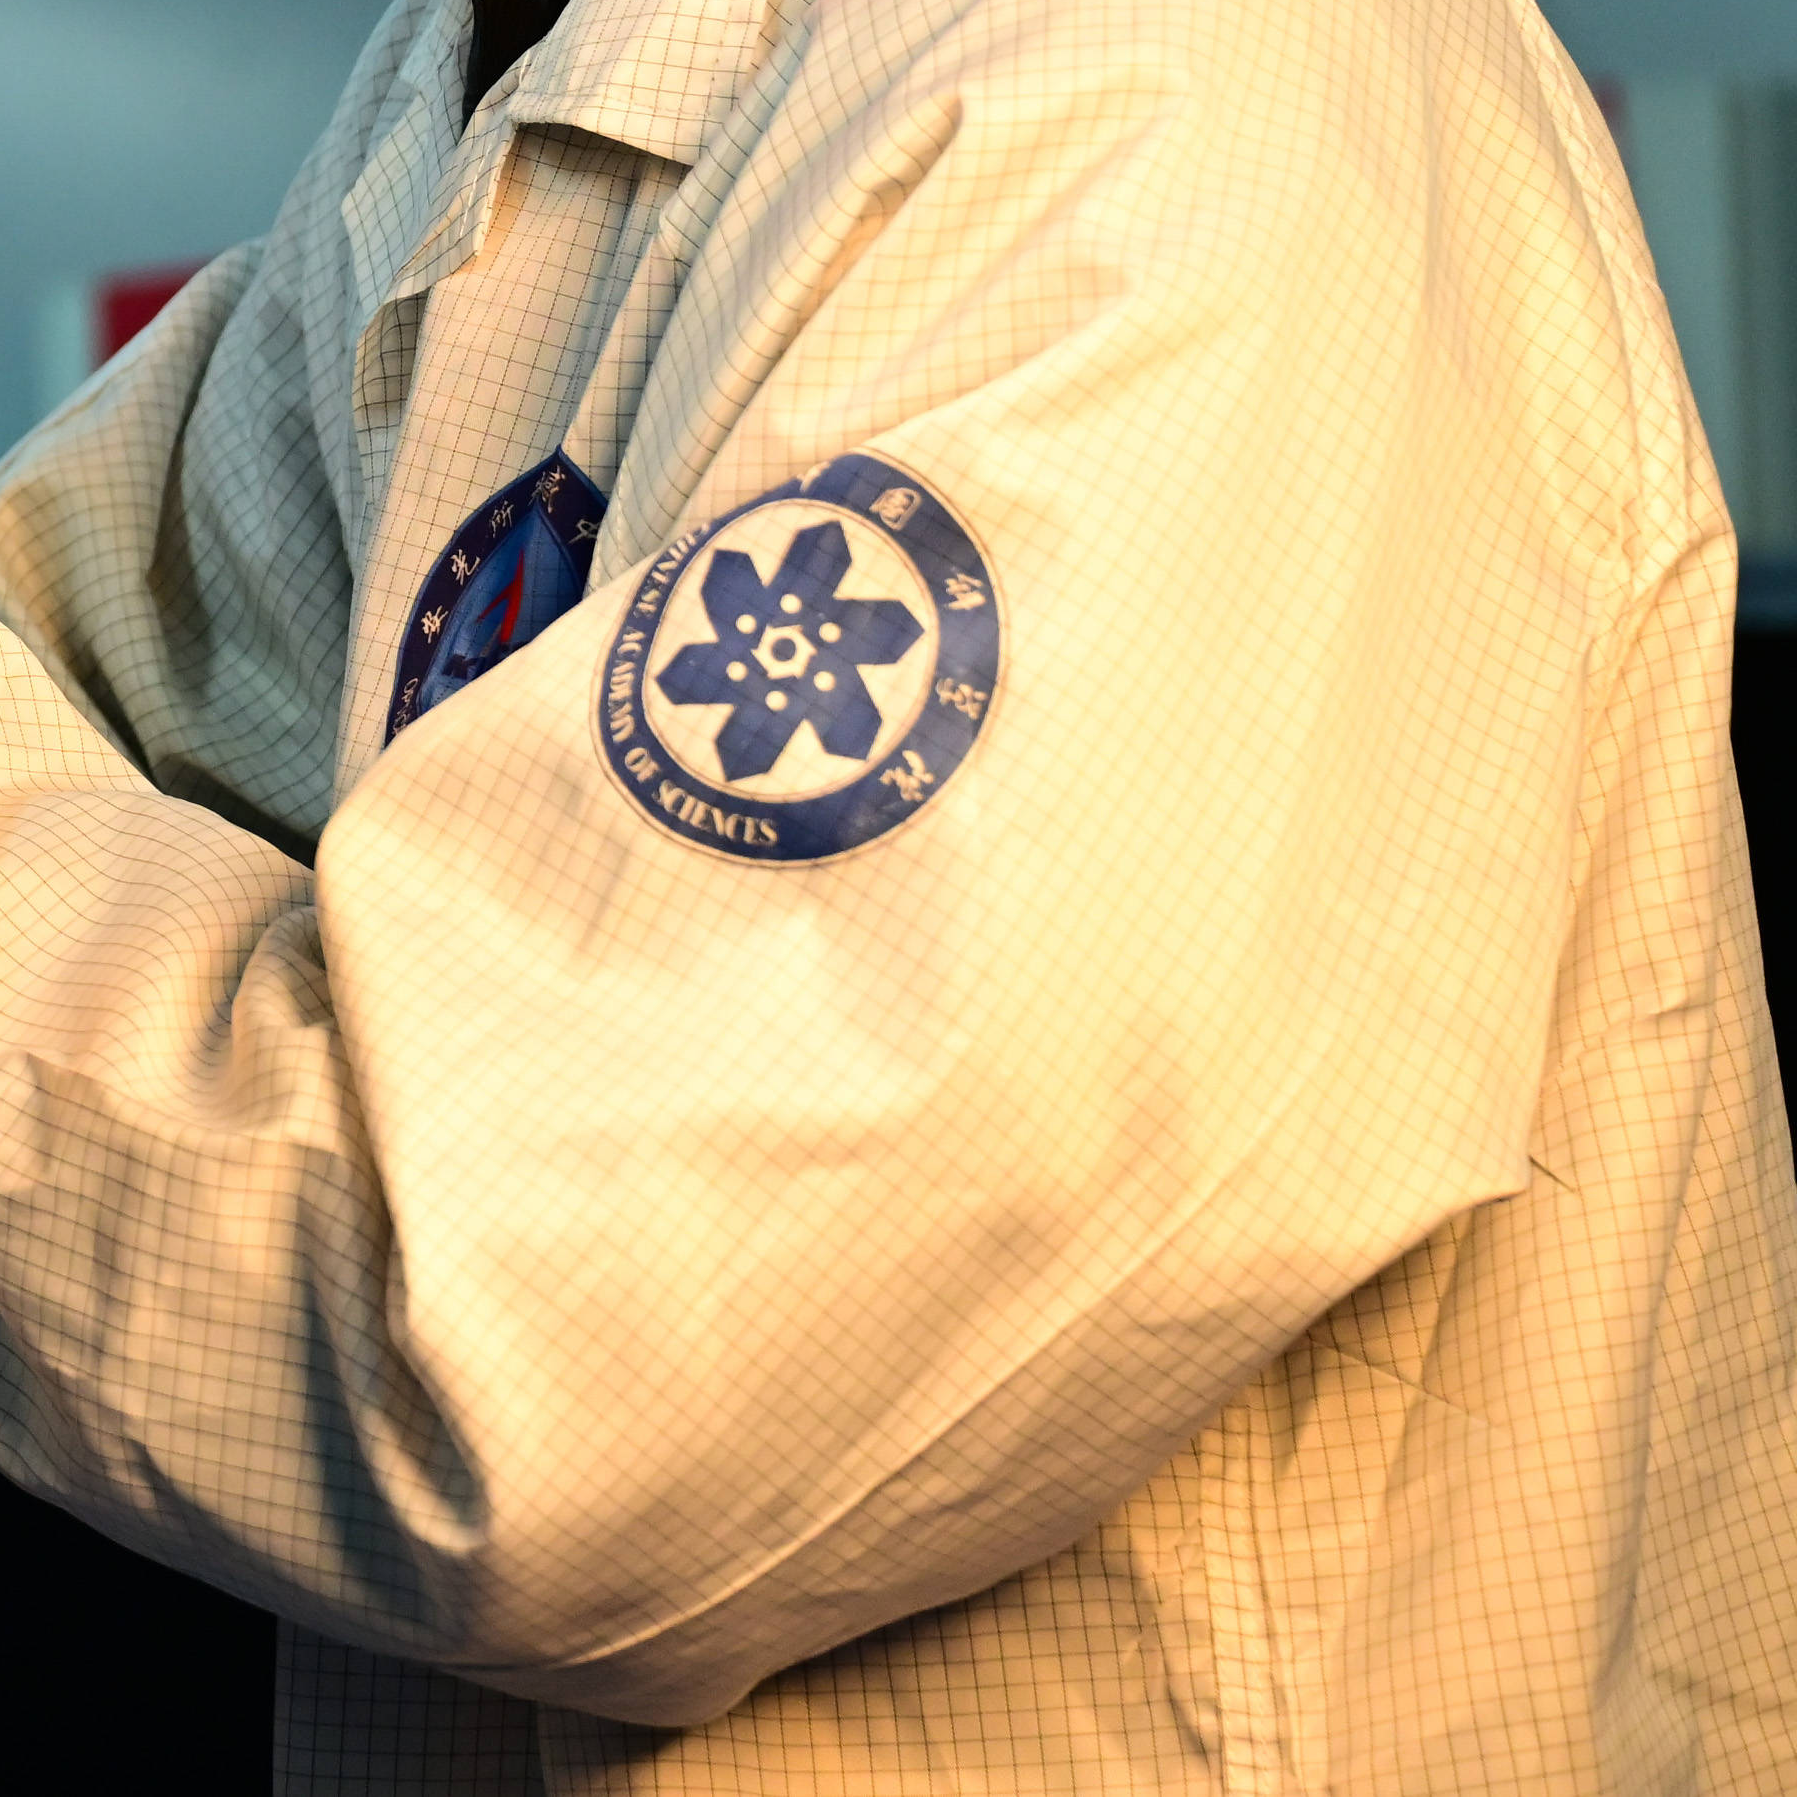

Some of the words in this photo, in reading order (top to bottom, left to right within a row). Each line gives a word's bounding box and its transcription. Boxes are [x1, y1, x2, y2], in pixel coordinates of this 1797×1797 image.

[608, 626, 646, 744] ACADEMY
[624, 747, 661, 783] OF
[653, 778, 779, 847] SCIENCES
